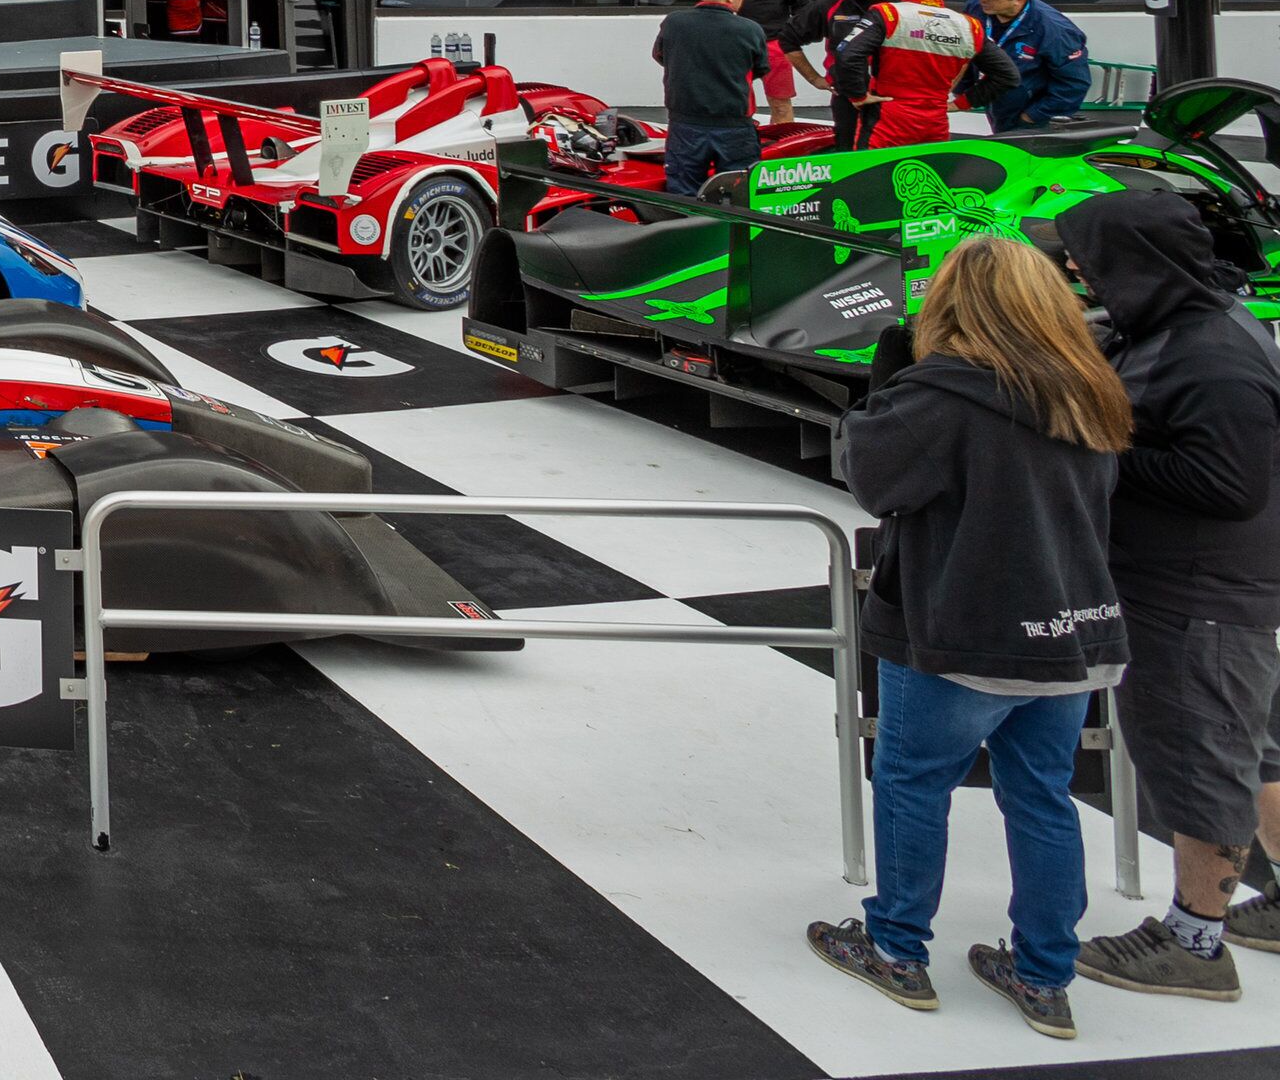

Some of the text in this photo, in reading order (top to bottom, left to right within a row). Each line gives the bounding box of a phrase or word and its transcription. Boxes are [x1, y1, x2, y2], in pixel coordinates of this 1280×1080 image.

[326, 102, 367, 116] IMVEST
[31, 130, 80, 188] G
[465, 148, 496, 162] Judd
[757, 162, 832, 188] AutoMax
[418, 184, 463, 207] MICHELIN
[775, 201, 821, 216] EVIDENT
[823, 281, 873, 299] POWERED BY
[829, 288, 885, 310] NISSAN
[841, 299, 893, 319] nismo
[267, 335, 416, 377] G
[474, 340, 516, 359] DUNLOP
[1021, 607, 1100, 637] THE BEFORE
